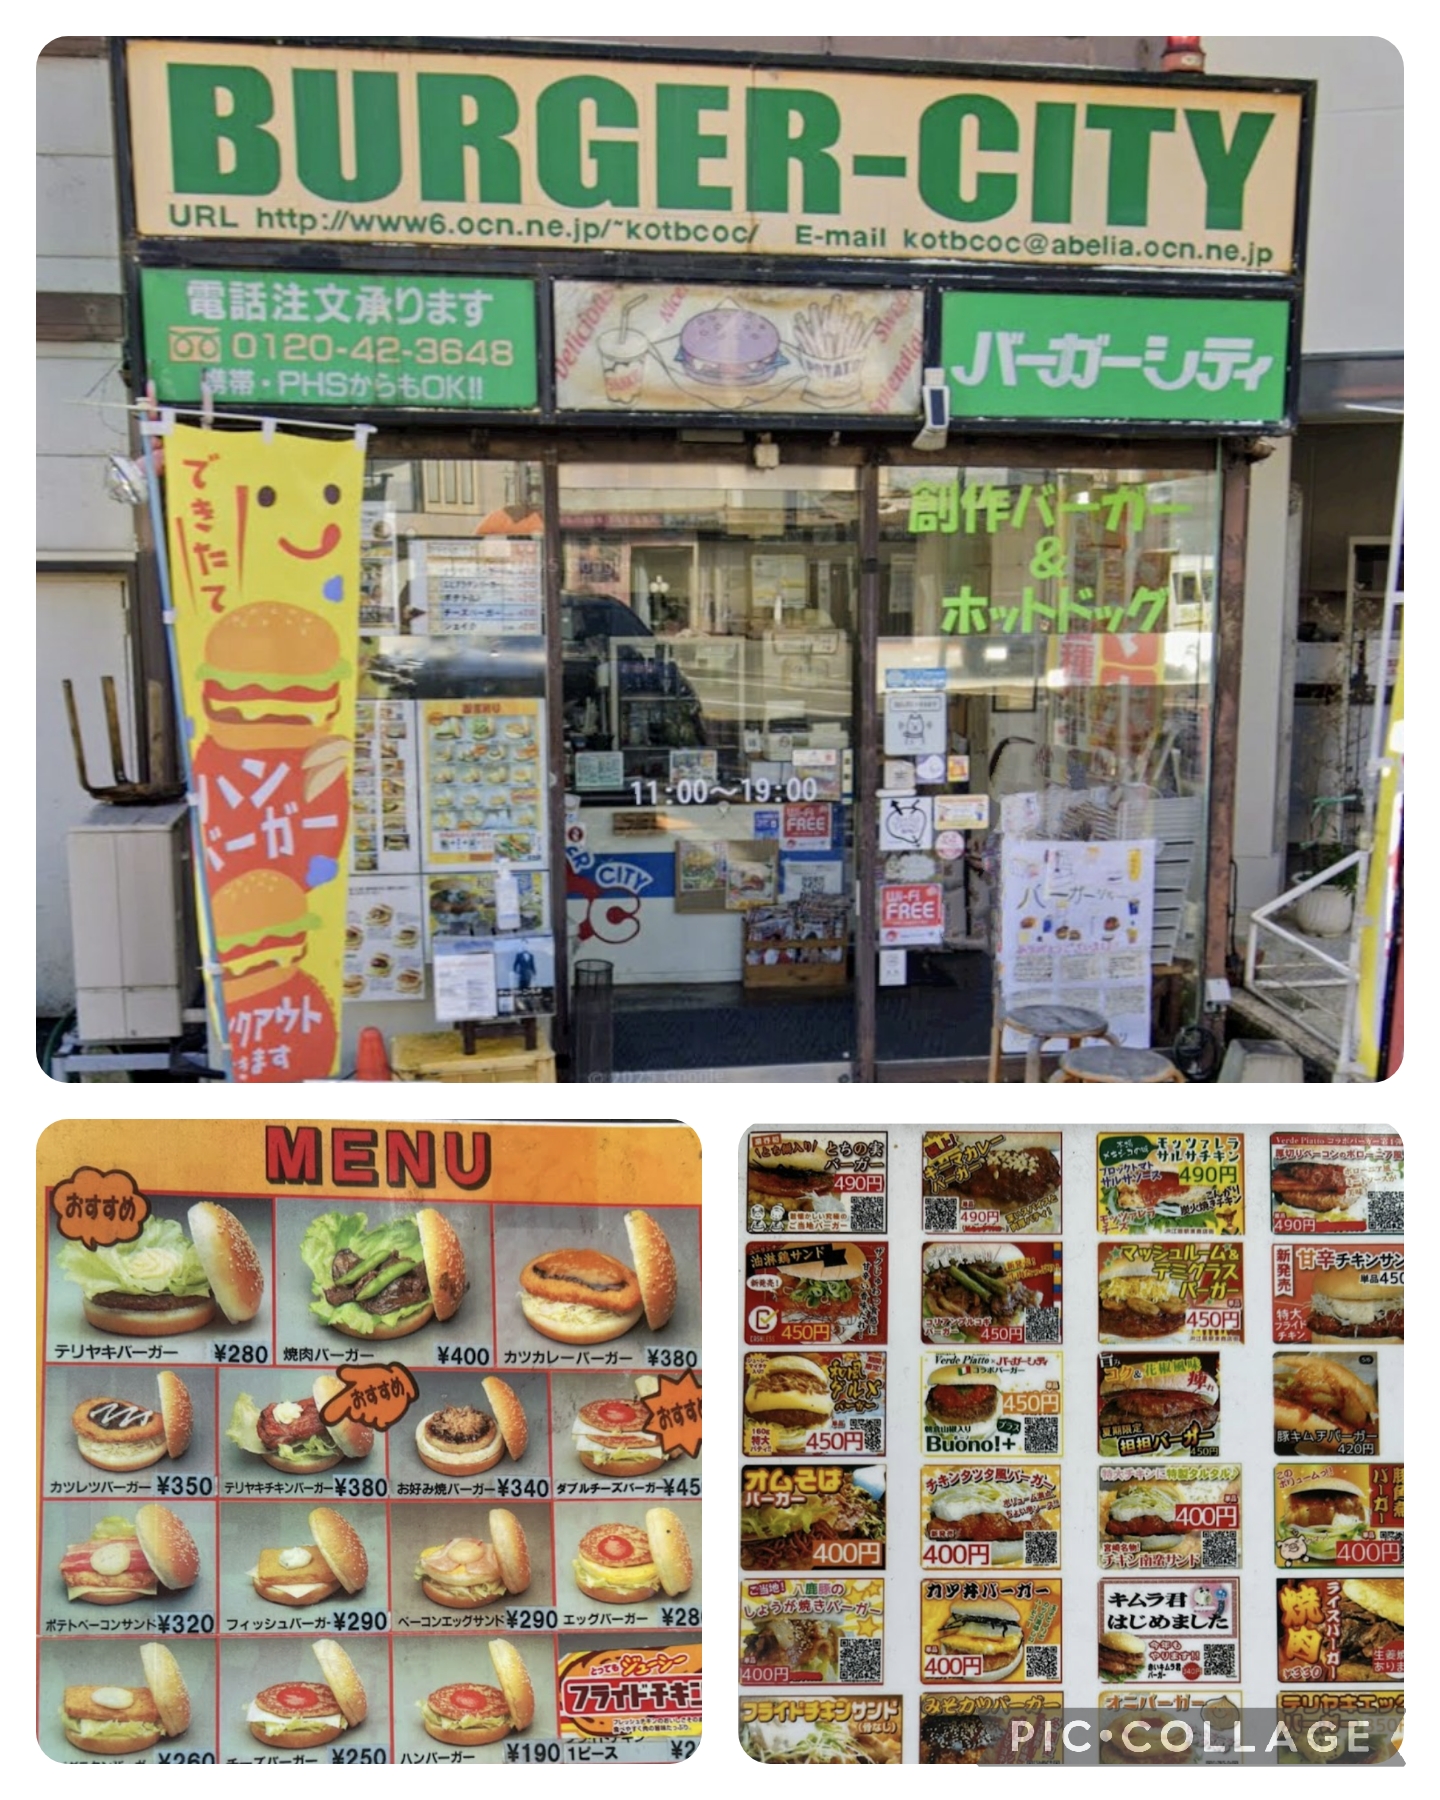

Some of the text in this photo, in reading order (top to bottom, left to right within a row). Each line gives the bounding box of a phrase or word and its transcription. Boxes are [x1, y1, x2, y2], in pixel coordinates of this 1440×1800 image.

[167, 62, 1276, 231] BURGER-CITY
[168, 205, 759, 246] URL http://www6.ocn.ne.jp/~kotbcoc/
[795, 225, 1274, 267] E-mail kotbcoc@abelia.ocn.ne.jp
[186, 280, 494, 328] 電話注文承ります
[231, 332, 515, 367] 0120-42-3648
[950, 330, 1275, 393] バーガーシティ
[907, 479, 1193, 534] 創作バーガー
[182, 452, 229, 614] できたて
[1029, 536, 1069, 580] &
[940, 584, 1171, 635] ホットドッグ
[786, 816, 826, 832] FREE
[597, 863, 652, 894] CITY
[885, 902, 936, 919] FREE
[825, 1141, 884, 1156] とちの実
[1157, 1137, 1239, 1149] モッツァレラ
[265, 1124, 492, 1191] MENU
[825, 1158, 884, 1172] バーガー
[924, 1135, 1004, 1180] キーマカレー
[1157, 1151, 1239, 1161] サルサチキン
[834, 1176, 883, 1191] 490円
[931, 1163, 981, 1193] バーガー
[1101, 1171, 1162, 1187] サルサソース
[1179, 1166, 1237, 1183] 490円
[66, 1192, 136, 1222] おすすめ
[961, 1211, 999, 1222] 490円
[1102, 1223, 1129, 1234] チーズ
[1275, 1220, 1315, 1232] 490円
[1121, 1244, 1239, 1261] マッシュルーム&
[1152, 1263, 1239, 1280] デミグラス
[1277, 1248, 1291, 1292] 新発売
[1361, 1275, 1379, 1283] 単品
[1179, 1282, 1239, 1299] バーガー
[1186, 1311, 1240, 1328] 450円
[1277, 1309, 1302, 1320] 特大
[781, 1324, 830, 1340] 450円
[981, 1328, 1023, 1341] 450円
[1275, 1322, 1307, 1331] フライド
[1278, 1331, 1306, 1341] チキン
[54, 1344, 179, 1360] テリヤキバーガー
[213, 1344, 268, 1364] ¥280
[283, 1347, 375, 1362] 焼肉バーガー
[437, 1346, 490, 1366] ¥400
[504, 1350, 633, 1365] カツカレーバーガー
[647, 1349, 698, 1367] ¥380
[935, 1355, 960, 1365] Verde
[962, 1356, 990, 1365] Piatto
[828, 1359, 865, 1381] 和風
[350, 1376, 405, 1410] おすすめ
[831, 1380, 882, 1400] グルメ
[1003, 1394, 1058, 1412] 450円
[657, 1399, 702, 1431] おすす
[806, 1432, 863, 1451] 450円
[1277, 1431, 1377, 1442] 豚キムチバーガー
[1191, 1447, 1218, 1456] 450円
[1338, 1444, 1374, 1454] 420円
[745, 1467, 844, 1493] オムそば
[926, 1467, 1056, 1494] チキンタツタ風バーガー
[1276, 1469, 1293, 1480] この
[50, 1481, 152, 1494] カツレツバーガー
[156, 1475, 213, 1496] ¥350
[224, 1481, 334, 1494] テリヤキチキンバーガー
[334, 1477, 388, 1497] ¥380
[396, 1482, 496, 1496] お好み焼バーガー
[497, 1478, 549, 1497] ¥340
[556, 1481, 664, 1495] ダブルチーズバーガー
[663, 1478, 702, 1497] ¥45
[746, 1493, 806, 1507] バーガー
[1373, 1468, 1388, 1524] バーガー
[1176, 1506, 1237, 1527] 400円
[813, 1542, 881, 1564] 400円
[923, 1544, 990, 1565] 400円
[1337, 1542, 1400, 1563] 400円
[749, 1582, 785, 1595] ご当地!
[926, 1582, 1050, 1599] カツ丼バーガー
[744, 1599, 882, 1618] しょうが焼きバーガー
[1108, 1592, 1188, 1608] キムラ君
[45, 1618, 156, 1632] ポテトベーコンサンド
[157, 1613, 215, 1634] ¥320
[333, 1611, 387, 1632] ¥290
[398, 1615, 505, 1629] ベーコンエッグサンド
[506, 1609, 558, 1630] ¥290
[563, 1612, 649, 1626] エッグバーガー
[661, 1607, 702, 1628] ¥28
[1108, 1614, 1229, 1629] はじめました
[1280, 1584, 1324, 1664] 焼肉
[1327, 1581, 1341, 1679] ライスバーガー
[1149, 1641, 1182, 1650] 今年も
[590, 1663, 619, 1676] とっても
[620, 1652, 688, 1678] ジューシー
[925, 1657, 982, 1675] 400円
[742, 1668, 789, 1681] 400円
[742, 1701, 899, 1723] フライドチキンサンド
[922, 1695, 1062, 1714] みそカツバーガー
[1106, 1695, 1205, 1712] オニバーガー
[401, 1752, 475, 1764] ハンバーガー
[507, 1743, 561, 1763] ¥190
[567, 1746, 618, 1761] 1ピース
[671, 1740, 699, 1760] ¥2
